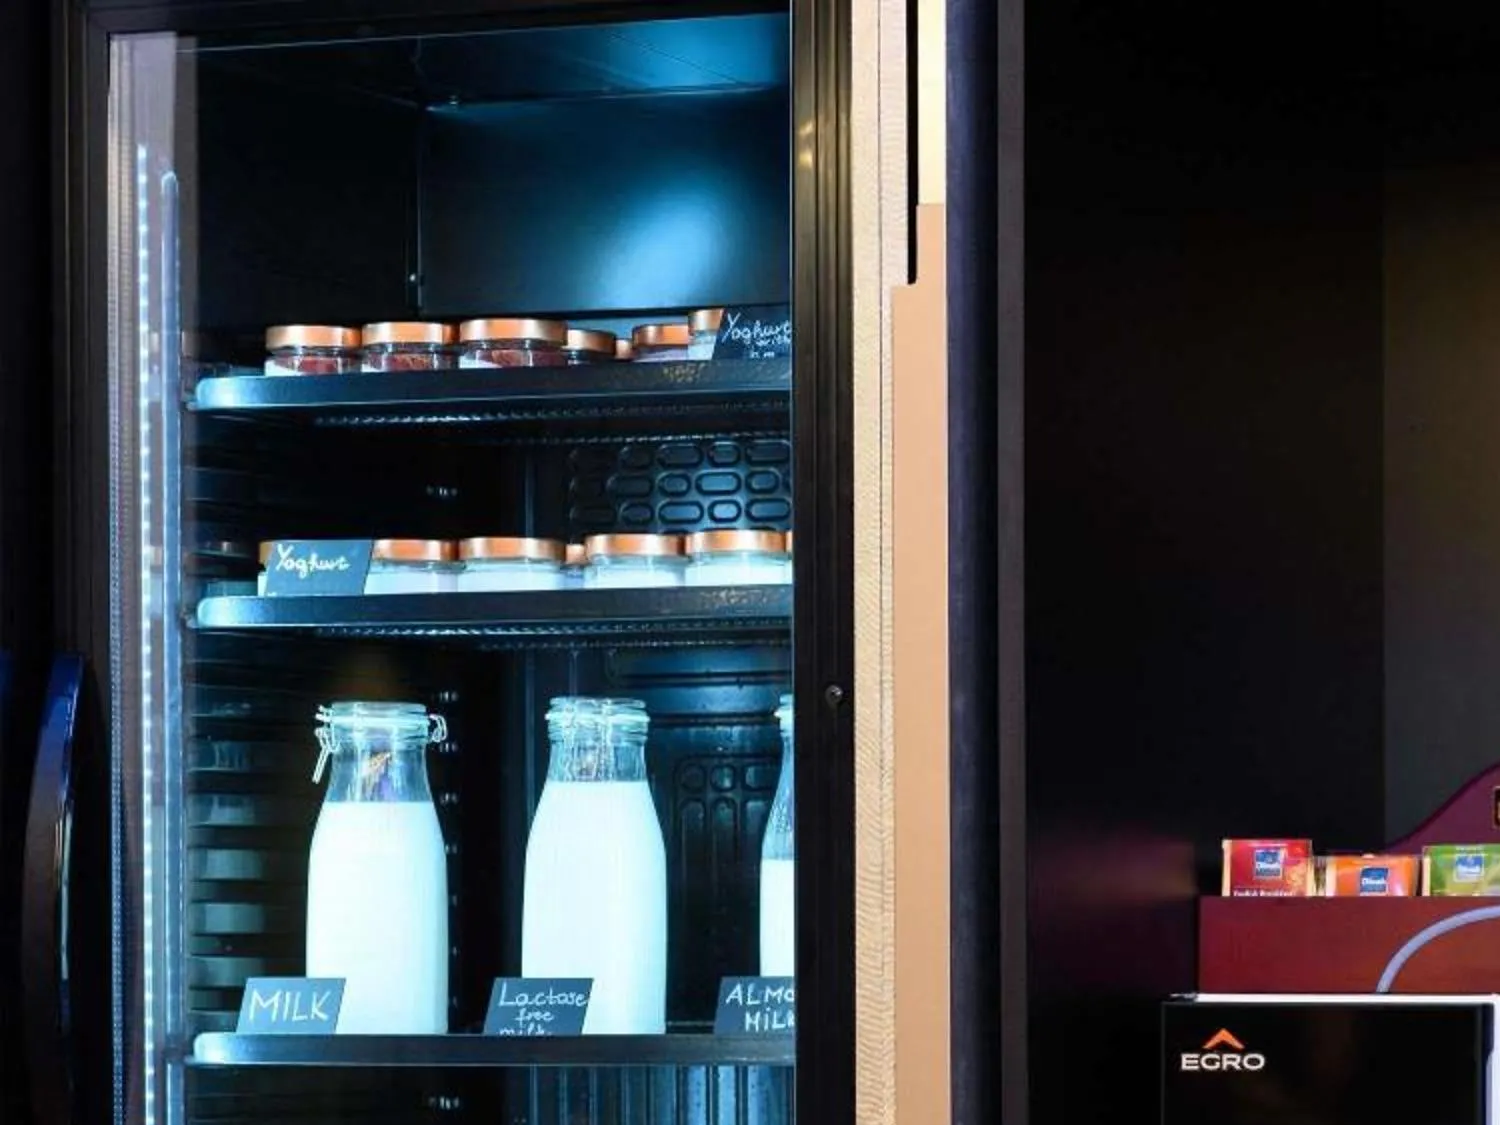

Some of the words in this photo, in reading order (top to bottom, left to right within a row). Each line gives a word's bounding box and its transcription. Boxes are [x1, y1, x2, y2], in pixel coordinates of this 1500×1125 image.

[275, 543, 351, 579] Yoghurt
[248, 989, 332, 1022] MILK
[515, 1007, 555, 1029] free
[1181, 1053, 1265, 1071] EGRO
